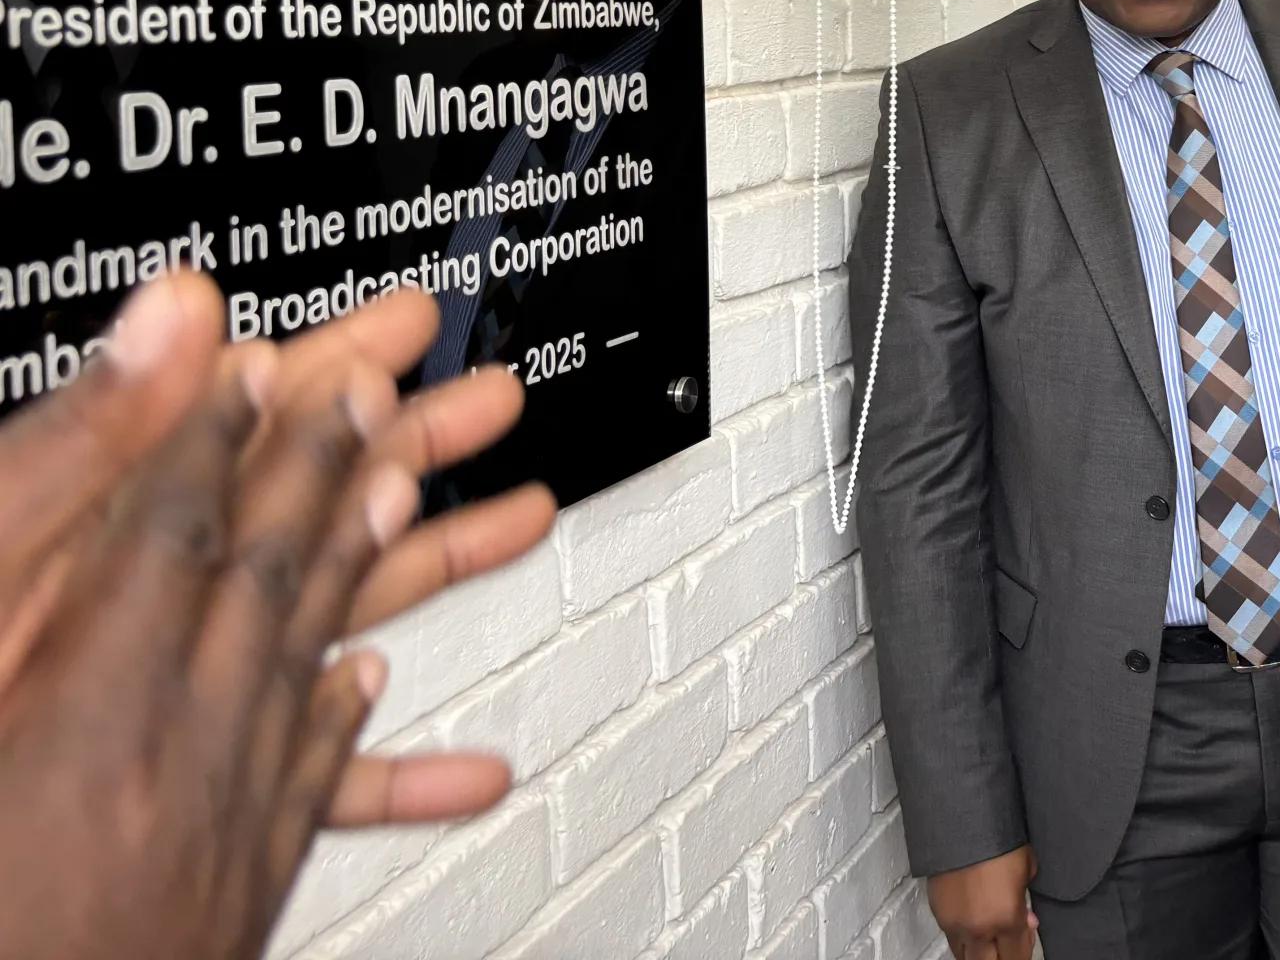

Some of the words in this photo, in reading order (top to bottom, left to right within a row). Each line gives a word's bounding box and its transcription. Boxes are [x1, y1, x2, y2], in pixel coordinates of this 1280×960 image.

[119, 91, 218, 172] Dr.
[242, 83, 303, 157] E.
[323, 78, 377, 147] D.
[395, 70, 648, 140] Mnangagwa
[230, 215, 269, 266] in
[279, 203, 345, 255] the
[355, 173, 577, 242] modernisation
[583, 162, 609, 196] of
[615, 152, 653, 190] the
[228, 249, 481, 344] Broadcasting
[489, 214, 644, 278] Corporation
[525, 331, 586, 386] 2025
